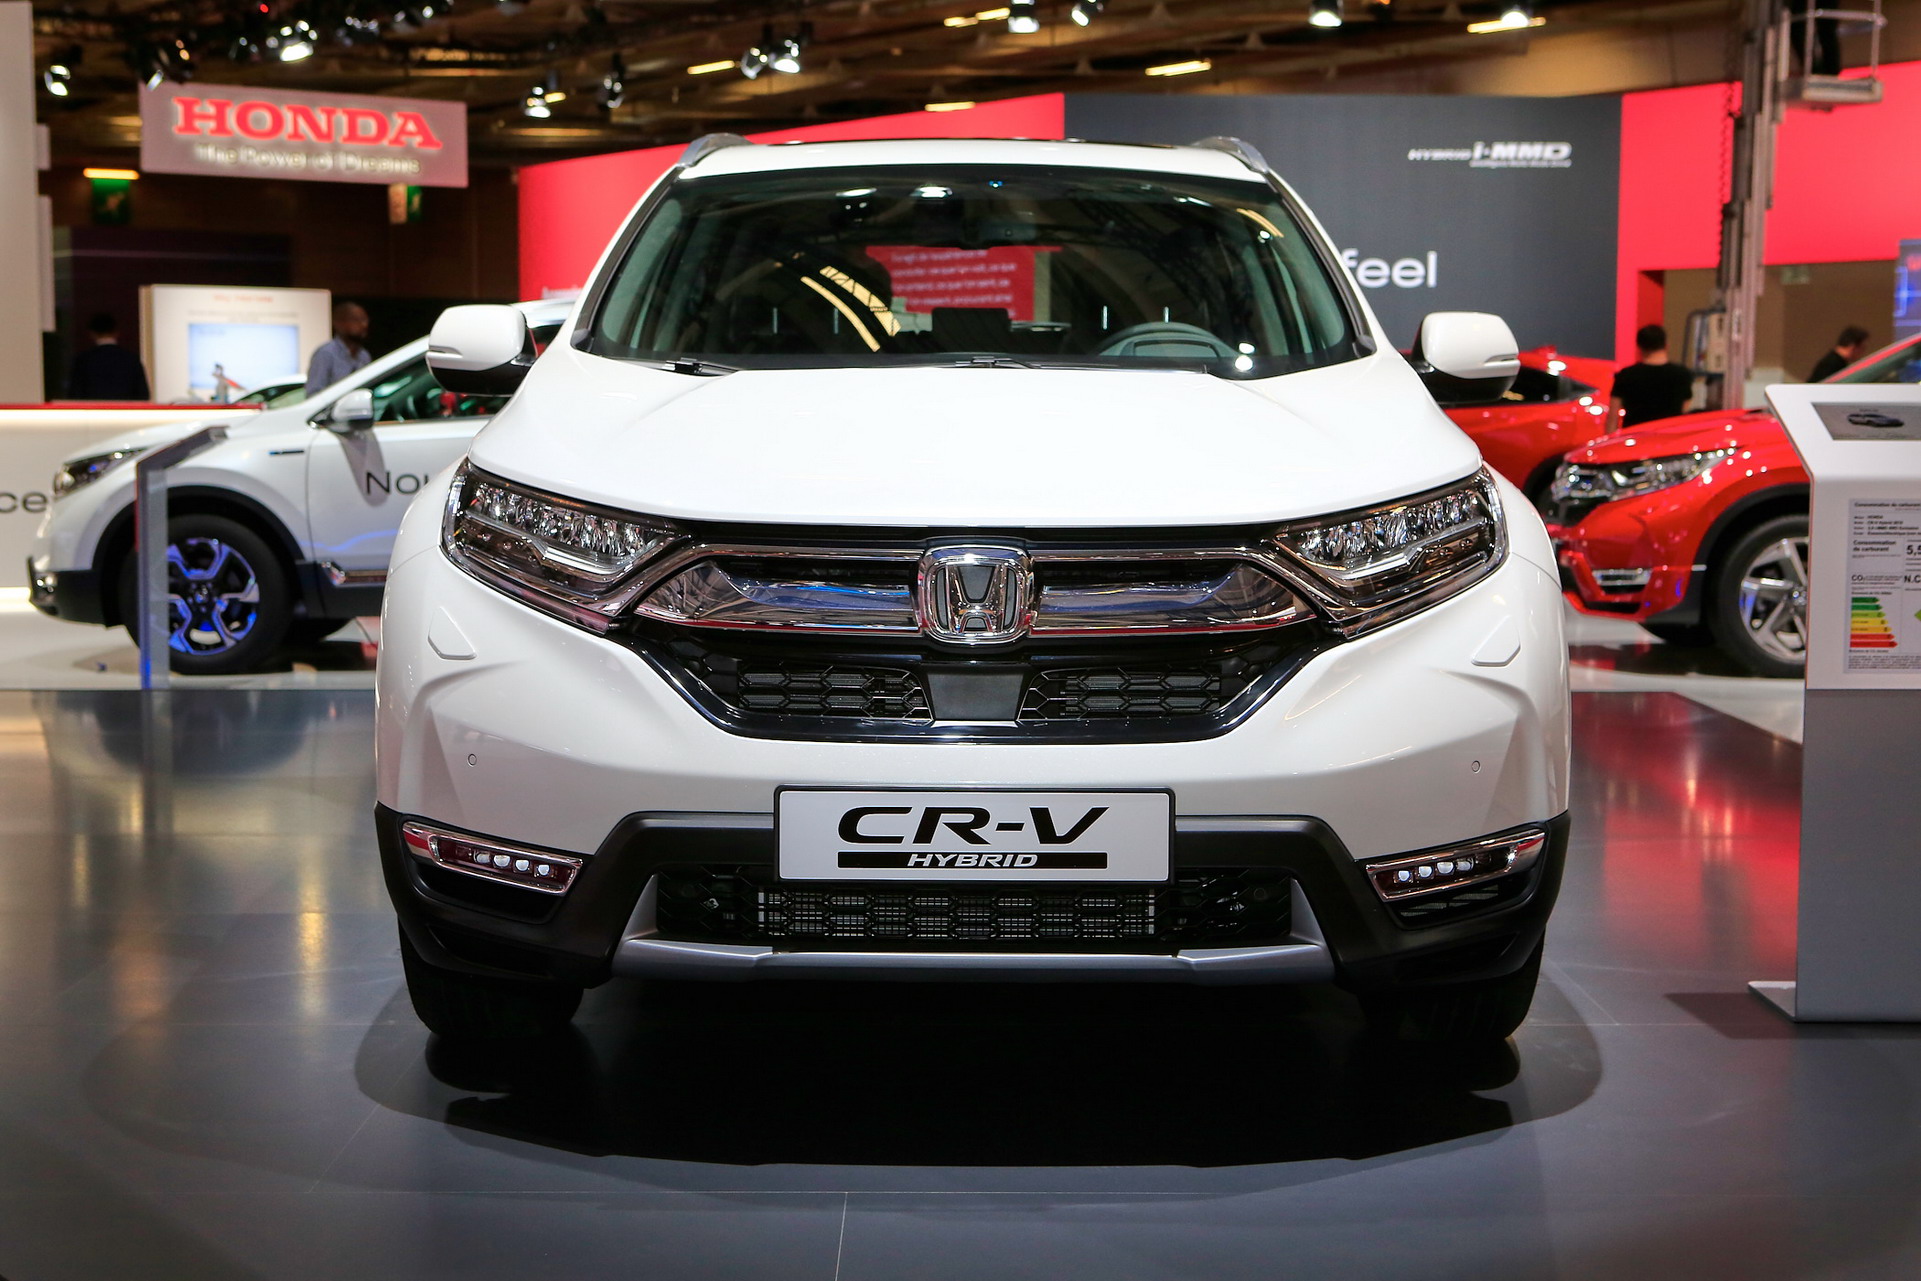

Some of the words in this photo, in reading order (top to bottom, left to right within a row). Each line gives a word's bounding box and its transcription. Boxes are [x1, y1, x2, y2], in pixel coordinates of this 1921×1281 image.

[173, 97, 442, 149] HONDA
[1341, 248, 1437, 288] feel
[838, 807, 1109, 844] CR-V
[907, 854, 1037, 867] HYBRID
